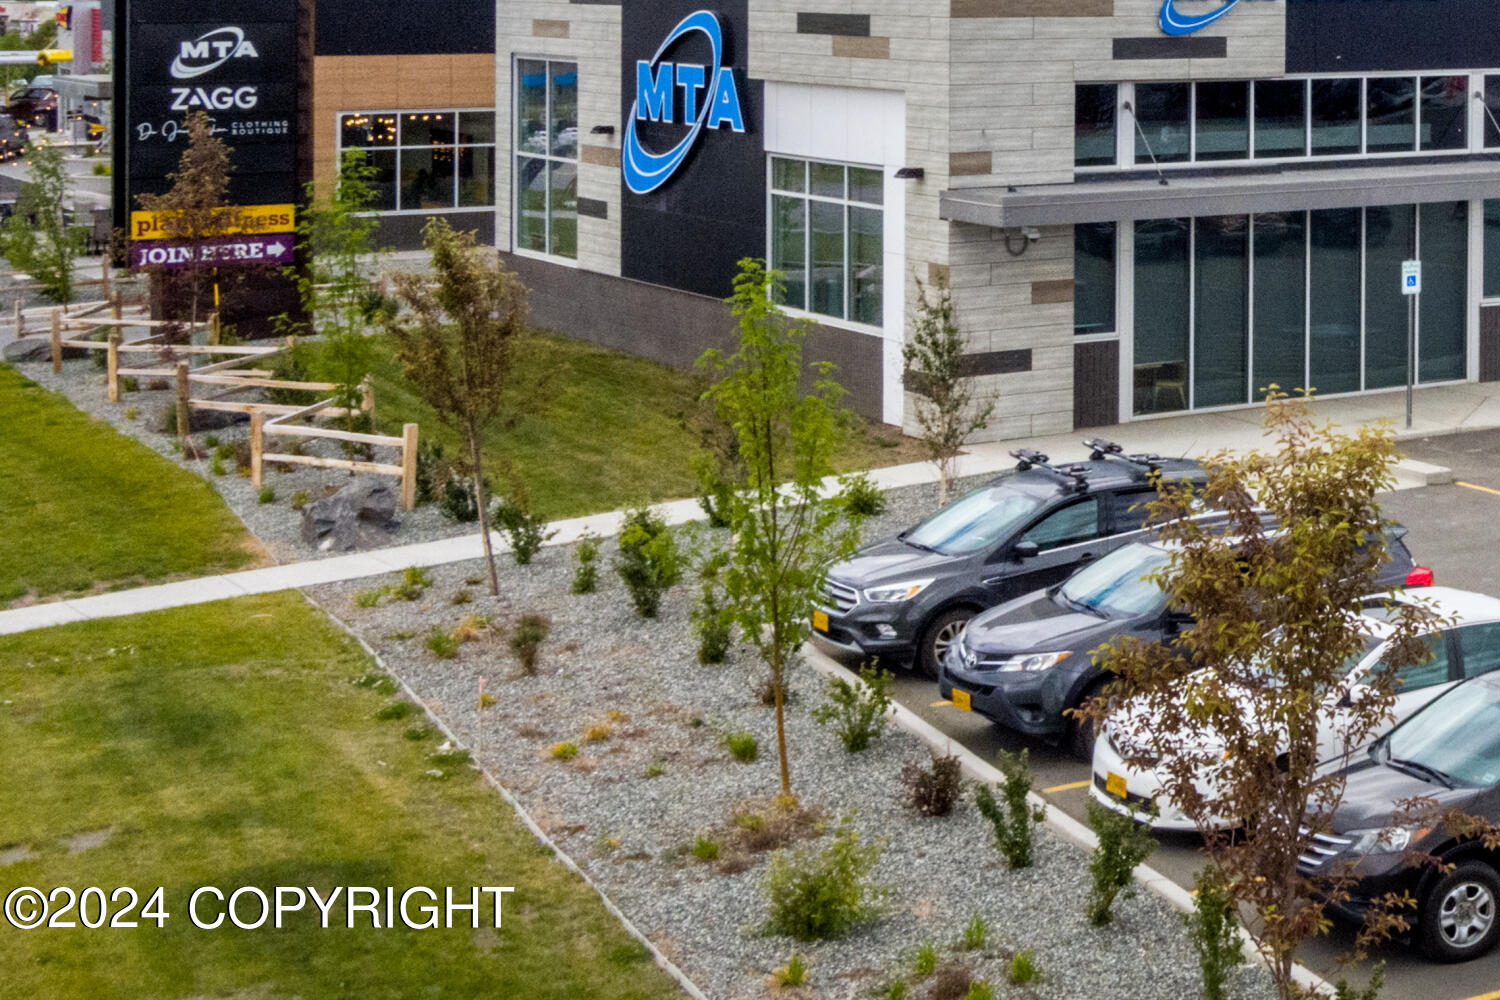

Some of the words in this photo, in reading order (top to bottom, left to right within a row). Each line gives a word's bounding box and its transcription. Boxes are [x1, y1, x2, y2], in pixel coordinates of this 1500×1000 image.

[180, 41, 259, 58] MTA
[171, 86, 258, 110] ZAGG
[636, 60, 745, 133] MTA
[231, 120, 289, 128] CLOTHING
